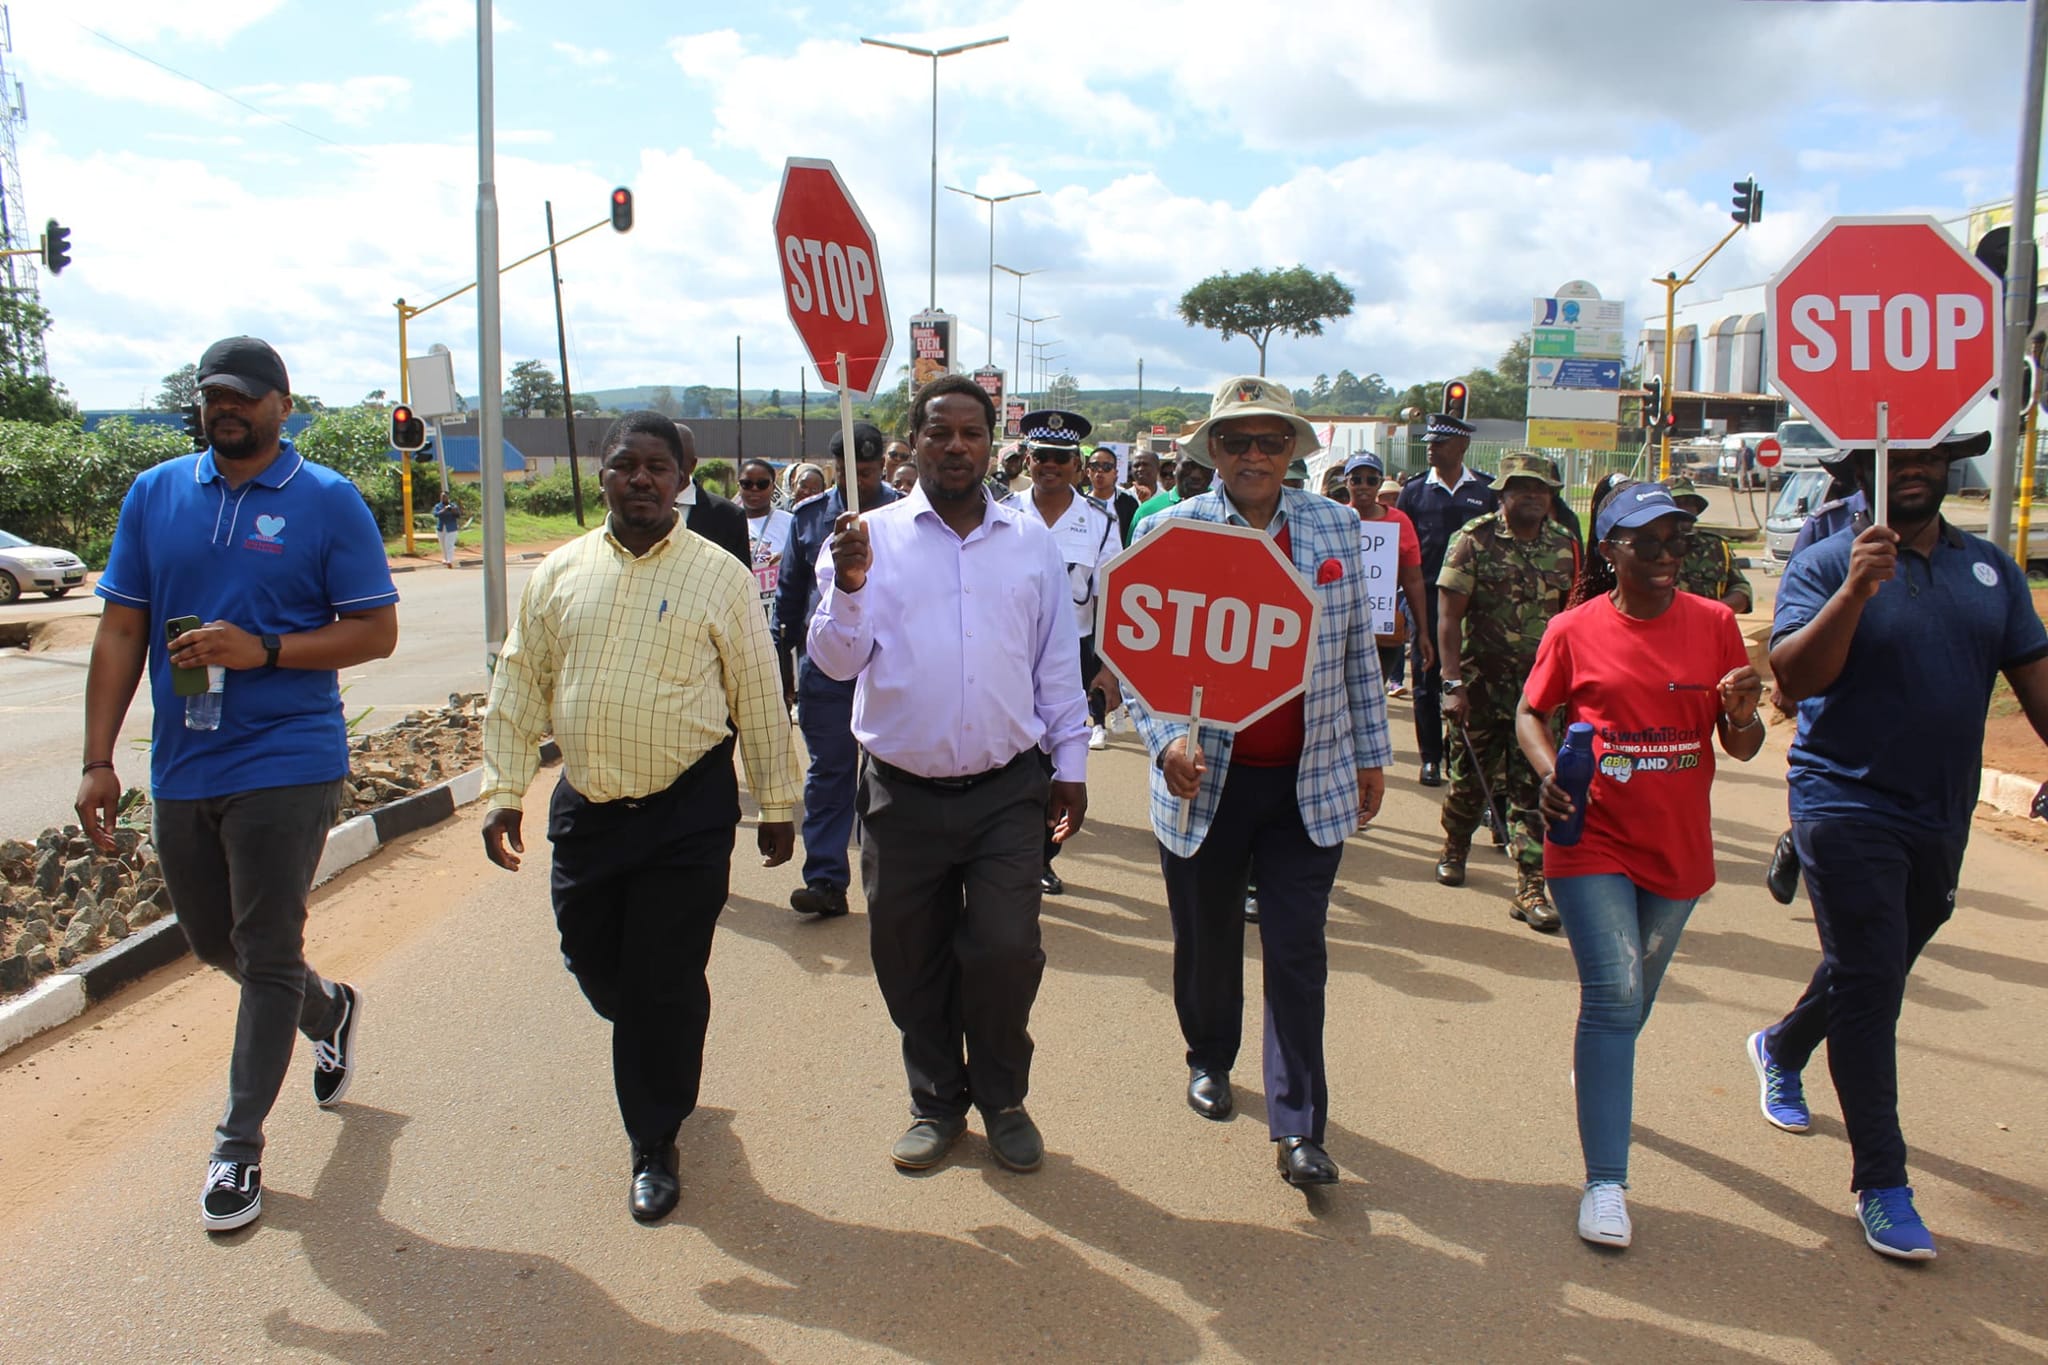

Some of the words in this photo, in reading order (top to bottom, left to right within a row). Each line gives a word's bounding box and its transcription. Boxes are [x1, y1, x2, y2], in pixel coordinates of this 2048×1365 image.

[785, 235, 874, 325] STOP
[917, 337, 940, 351] EVEN
[1790, 293, 1985, 373] STOP
[1117, 583, 1302, 671] STOP
[1603, 755, 1631, 767] GBV
[1637, 758, 1668, 770] AND
[1612, 744, 1641, 753] TAKING
[1649, 744, 1668, 753] LEAD
[1669, 743, 1677, 752] IN
